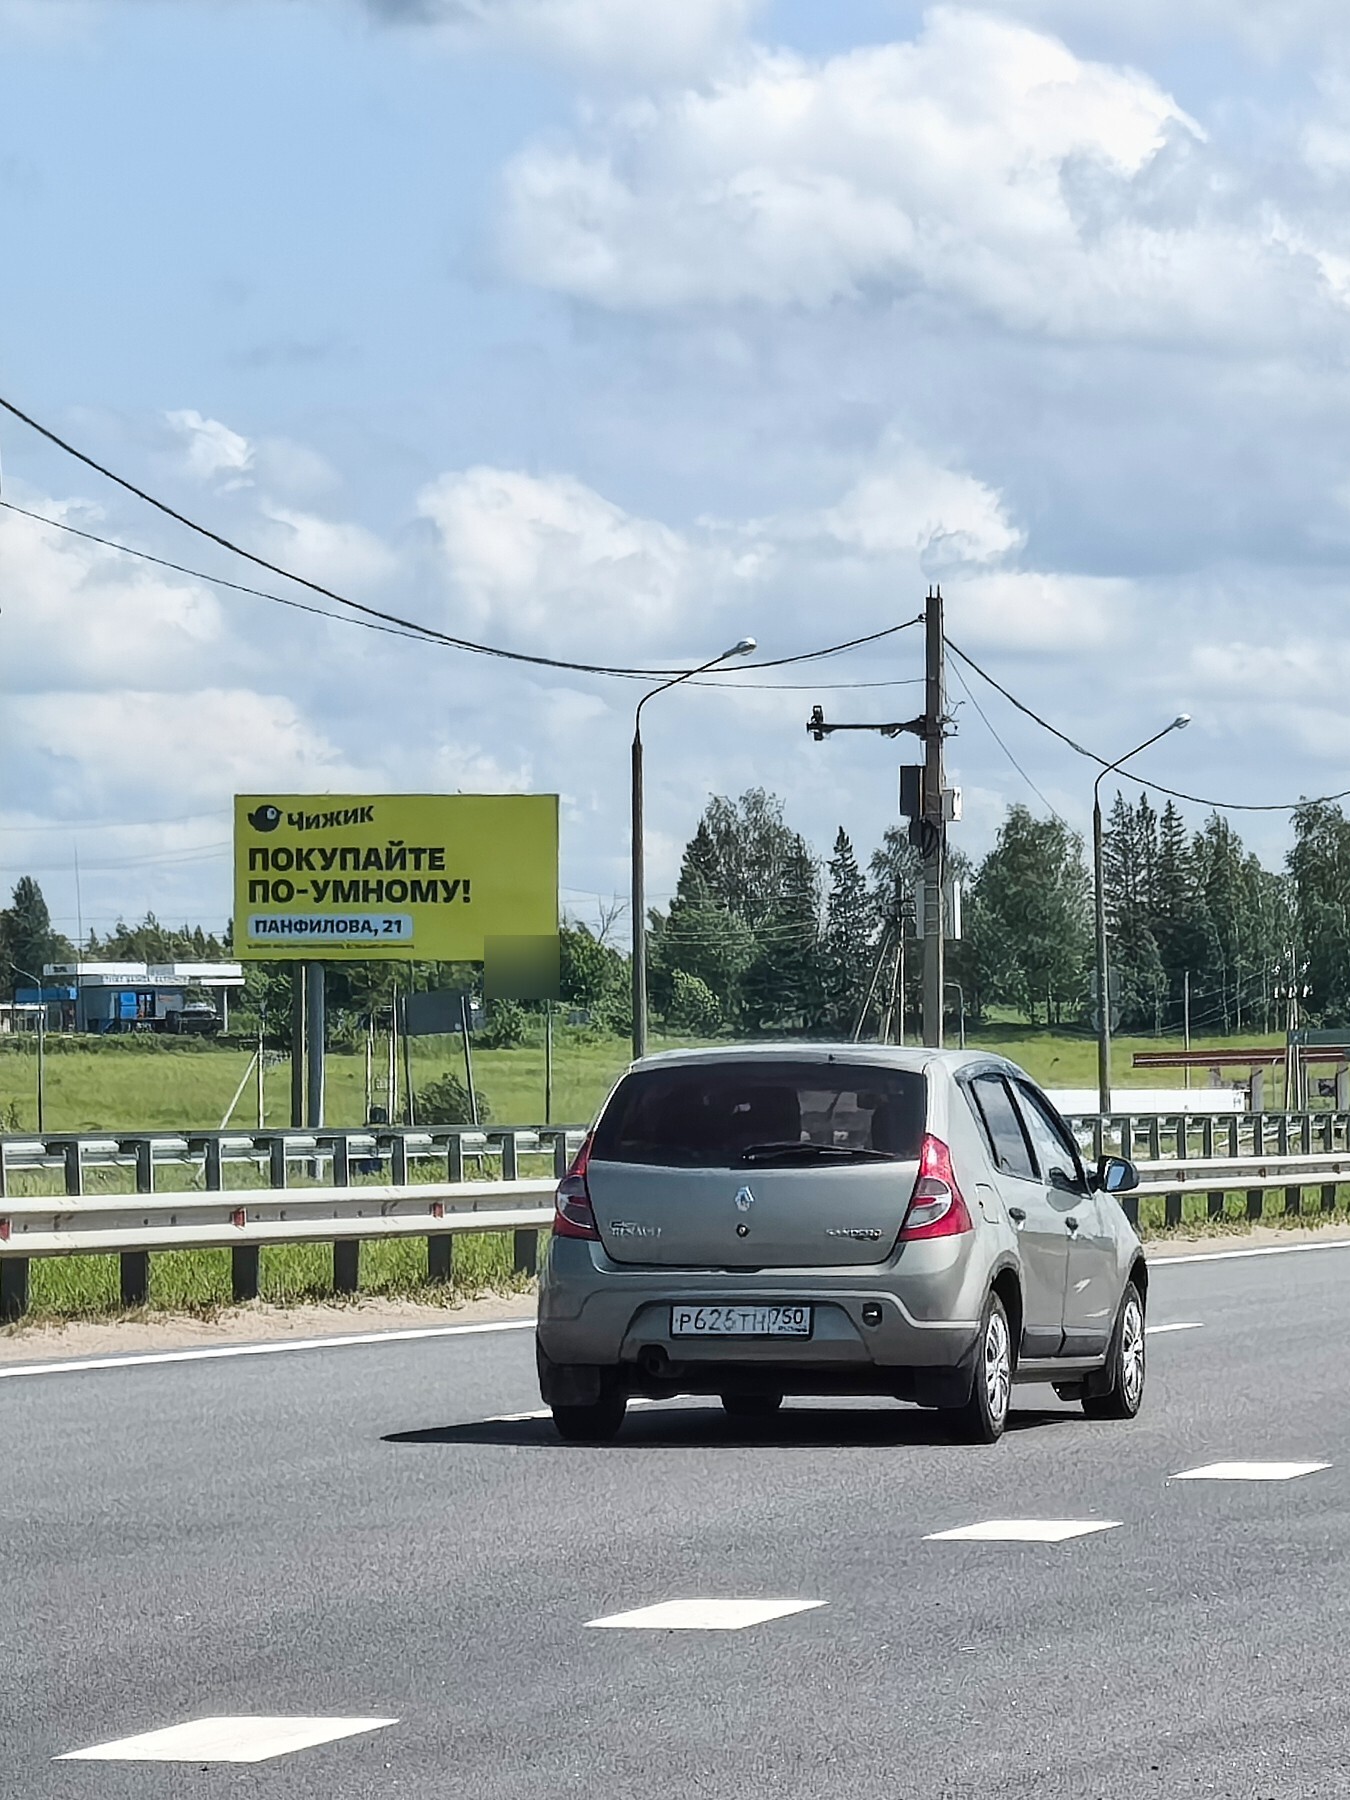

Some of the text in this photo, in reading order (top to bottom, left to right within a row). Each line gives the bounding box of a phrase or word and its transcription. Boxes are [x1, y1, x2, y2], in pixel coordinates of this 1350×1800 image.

[249, 840, 445, 871] ПОКУПАЙТЕ
[249, 879, 470, 903] ПО-УМНОМУ!
[255, 919, 402, 936] ПАНФИЛОВА, 21
